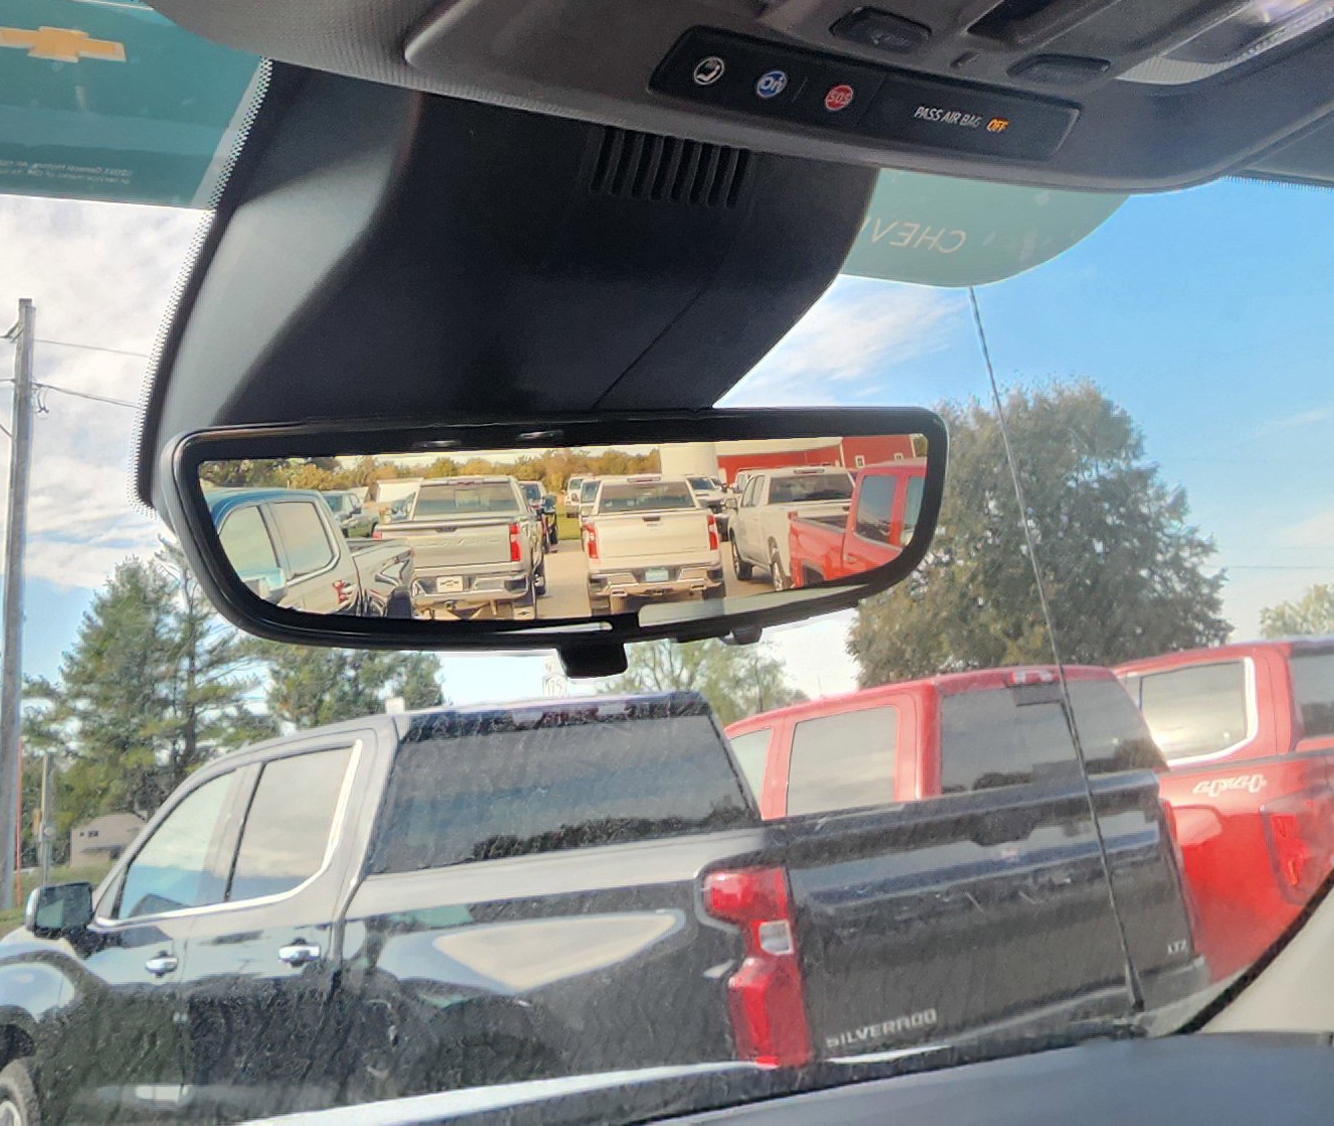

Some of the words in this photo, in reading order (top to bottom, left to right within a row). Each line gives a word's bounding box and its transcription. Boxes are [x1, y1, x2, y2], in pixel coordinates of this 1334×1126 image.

[913, 105, 944, 122] PASS
[941, 111, 962, 125] AIR
[959, 114, 984, 128] BAG
[825, 1007, 938, 1049] SILVERADO
